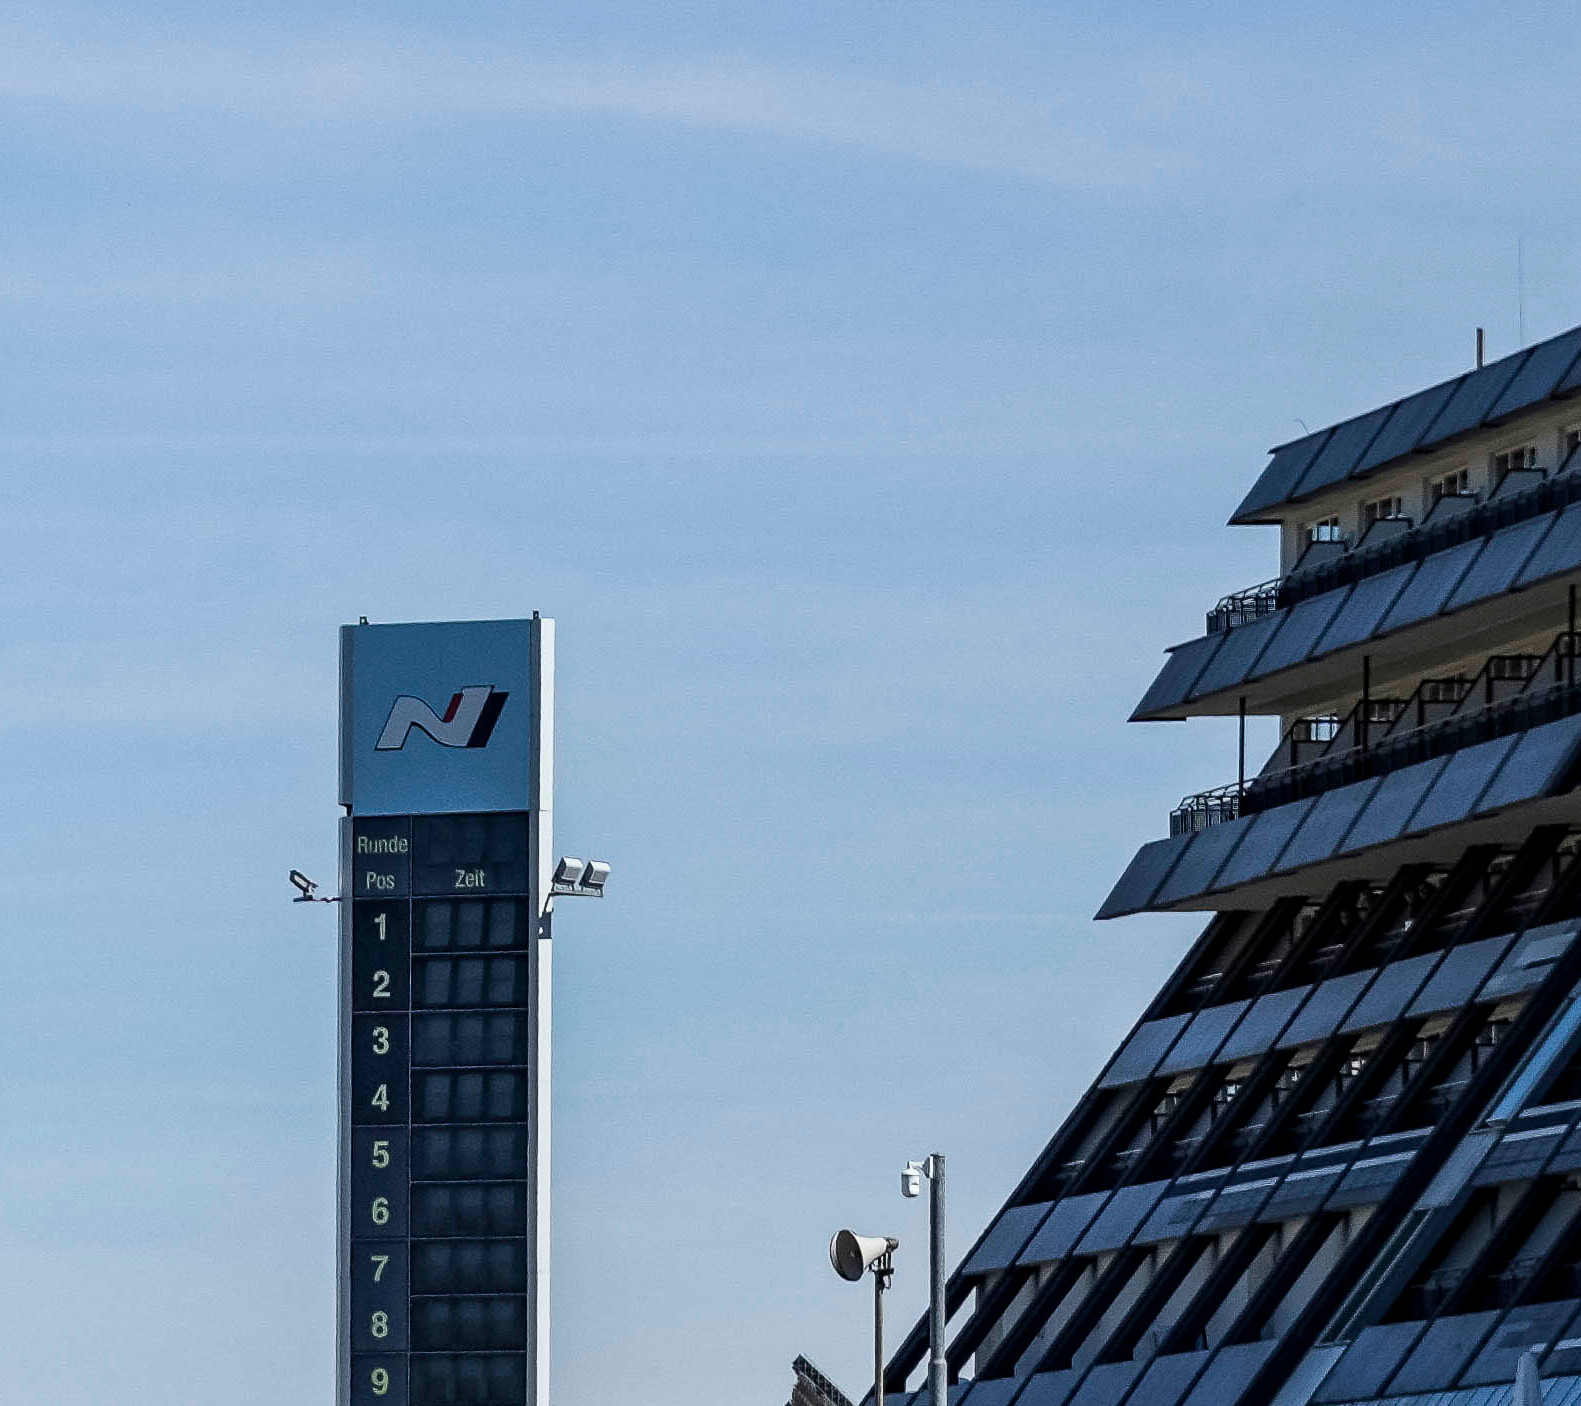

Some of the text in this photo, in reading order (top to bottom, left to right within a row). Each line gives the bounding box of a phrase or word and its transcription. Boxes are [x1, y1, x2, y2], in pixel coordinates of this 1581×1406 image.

[357, 835, 409, 854] Runde
[366, 869, 485, 890] Pos Zeit
[374, 913, 387, 941] 1
[372, 970, 391, 998] 2
[372, 1026, 390, 1055] 3
[371, 1083, 390, 1111] 4
[372, 1140, 390, 1169] 5
[371, 1197, 390, 1226] 6
[371, 1255, 389, 1282] 7
[371, 1310, 389, 1338] 8
[371, 1368, 389, 1395] 9
